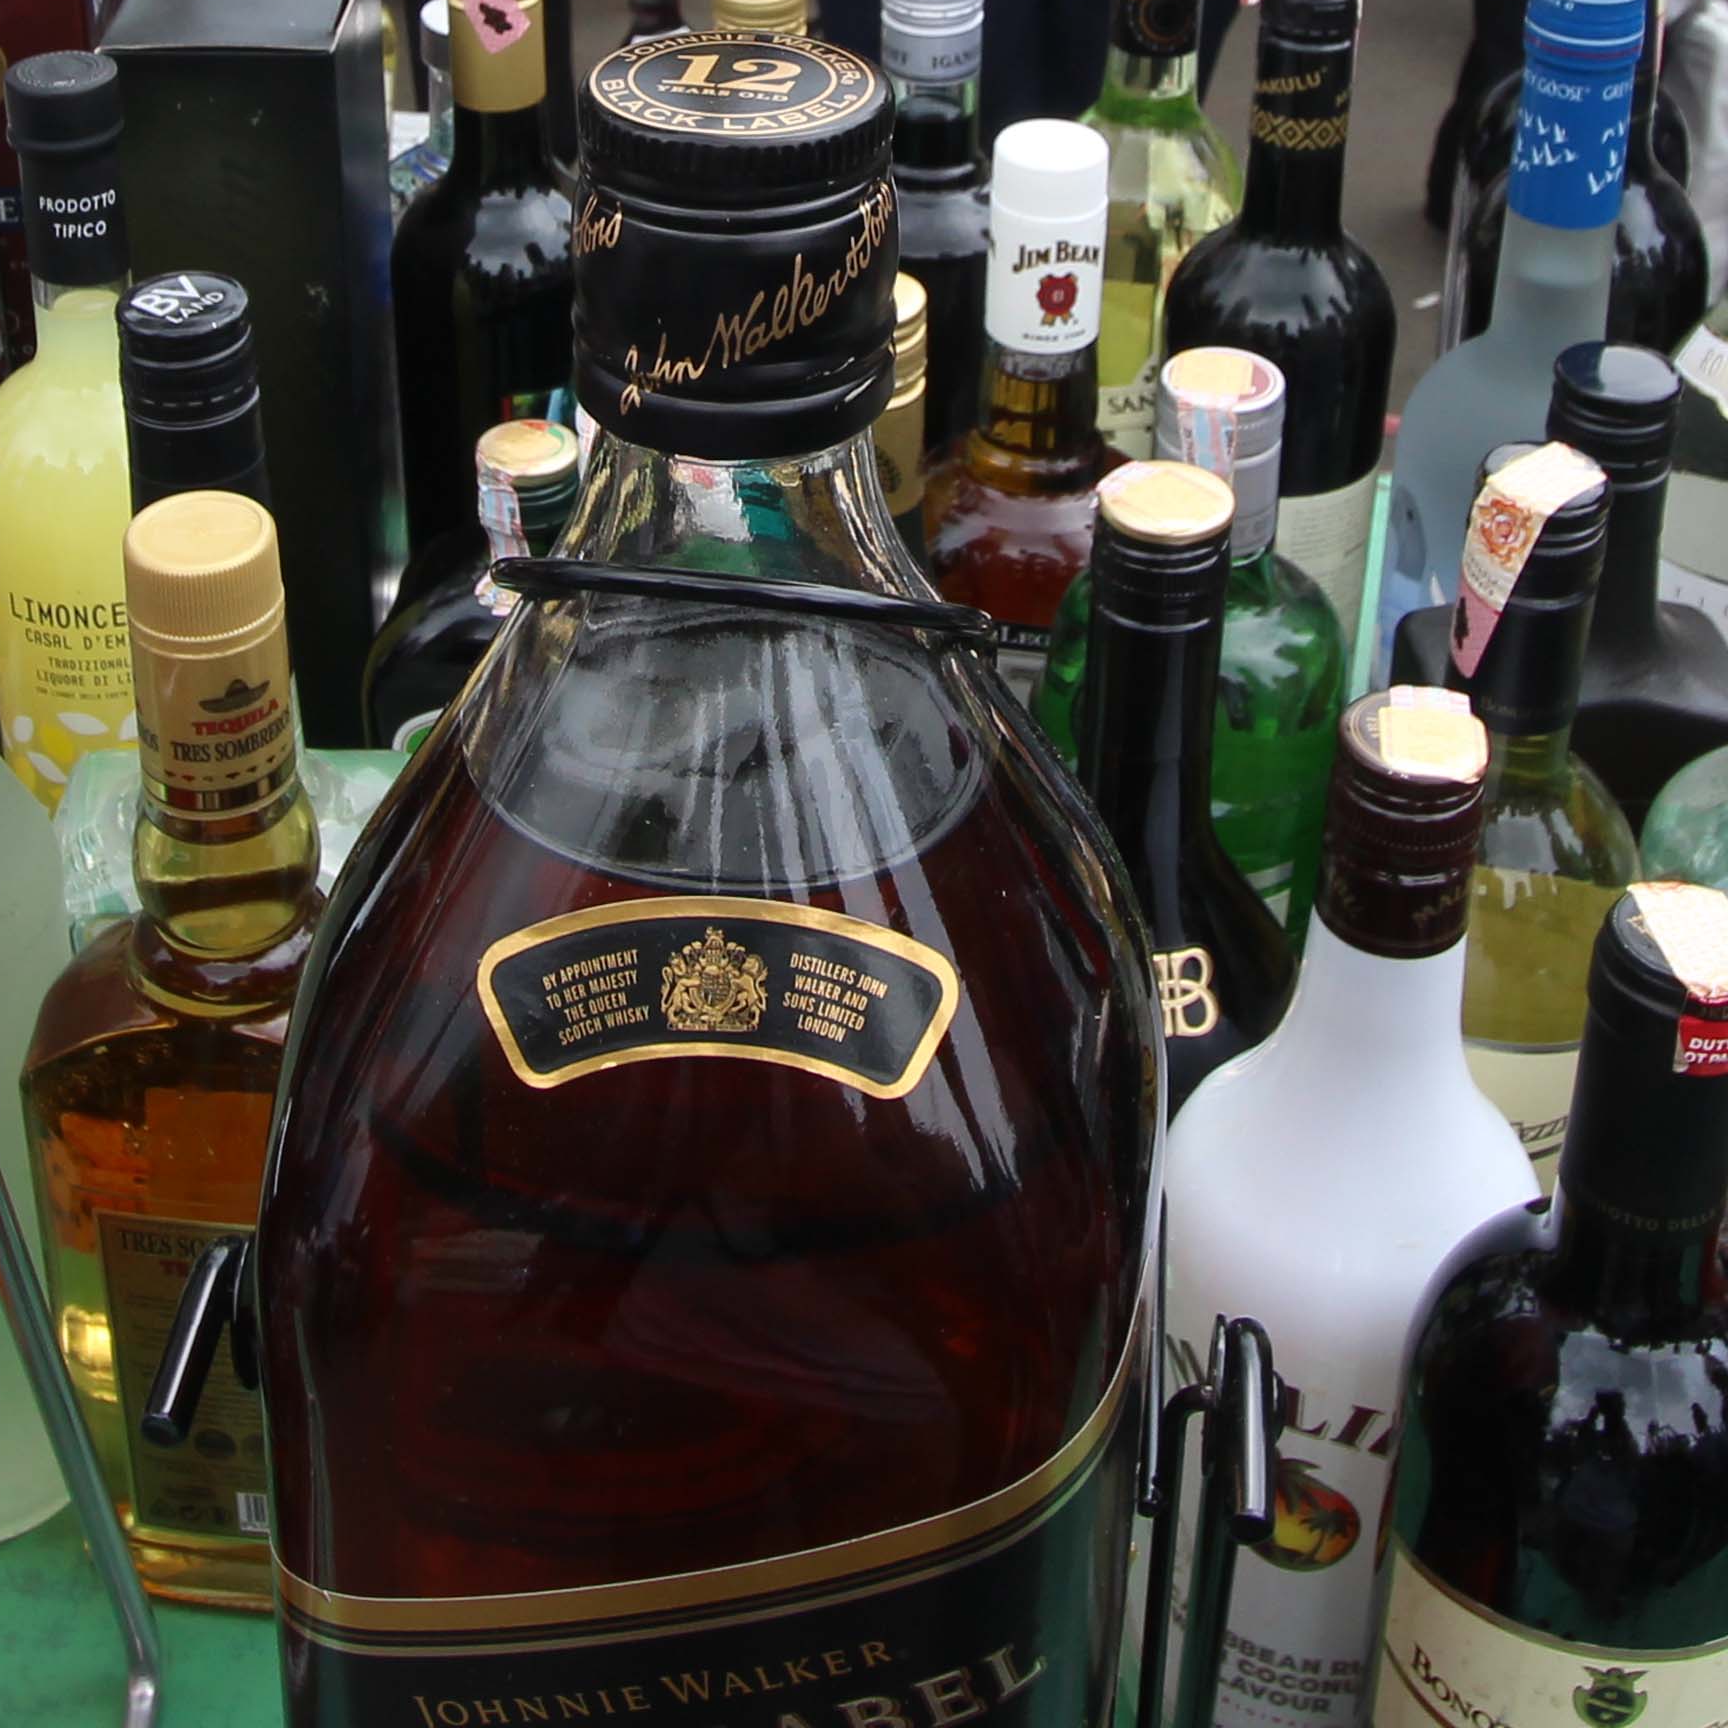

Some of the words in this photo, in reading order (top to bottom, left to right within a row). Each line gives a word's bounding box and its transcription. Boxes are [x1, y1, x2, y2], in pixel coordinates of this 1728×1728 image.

[621, 33, 756, 63] JOHNNIE
[772, 35, 861, 85] WALKER
[663, 54, 802, 93] 12
[601, 78, 698, 127] BLACK
[723, 93, 853, 129] LABEL
[656, 84, 731, 97] YEARS
[738, 92, 789, 102] OLD
[39, 189, 116, 214] PRODOTTO
[53, 220, 107, 239] TIPICO
[1012, 244, 1051, 274] JIM
[130, 274, 201, 317] BV
[164, 291, 225, 325] LAND
[25, 628, 73, 651] CASAL
[36, 670, 85, 687] LIQUORE
[93, 674, 108, 686] DI
[192, 698, 280, 737] TEQUILA
[170, 740, 211, 763] TRES
[542, 972, 558, 991] BY
[560, 949, 638, 984] APPOINTMENT
[790, 953, 857, 985] DISTILLERS
[856, 973, 888, 999] JOHN
[546, 993, 562, 1010] TO
[563, 983, 587, 1004] HER
[589, 970, 638, 994] MAJESTY
[564, 1003, 587, 1023] THE
[589, 992, 627, 1015] QUEEN
[794, 974, 842, 1001] WALKER
[842, 990, 868, 1011] AND
[558, 1017, 603, 1046] SCOTCH
[604, 1005, 650, 1029] WHISKY
[783, 992, 816, 1013] SONS
[817, 1001, 865, 1031] LIMITED
[797, 1014, 847, 1043] LONDON
[118, 1229, 173, 1254] TRES
[412, 1683, 652, 1728] JOHNNIE
[659, 1641, 894, 1705] WALKER
